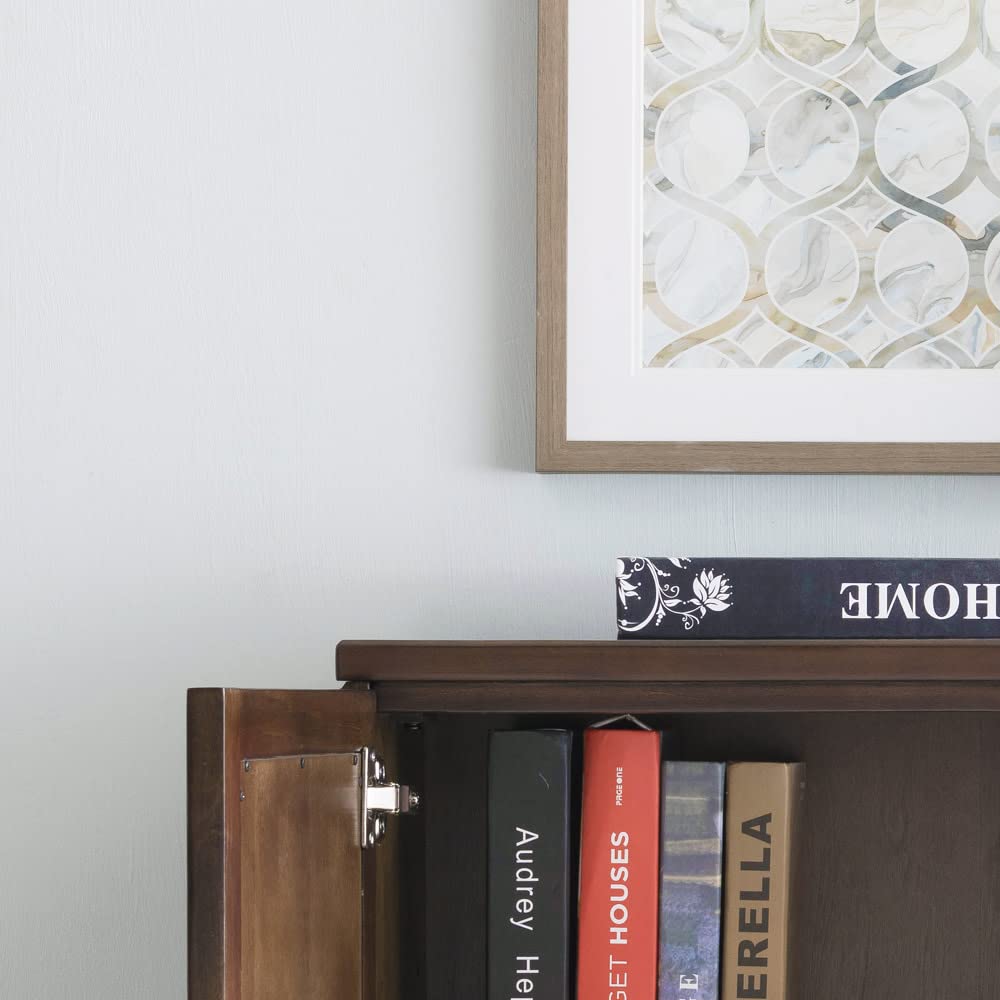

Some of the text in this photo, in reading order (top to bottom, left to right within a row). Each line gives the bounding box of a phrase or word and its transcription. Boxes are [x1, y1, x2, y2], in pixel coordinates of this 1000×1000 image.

[839, 582, 1000, 620] HOME
[509, 826, 540, 931] Audrey
[609, 831, 630, 945] HOUSES
